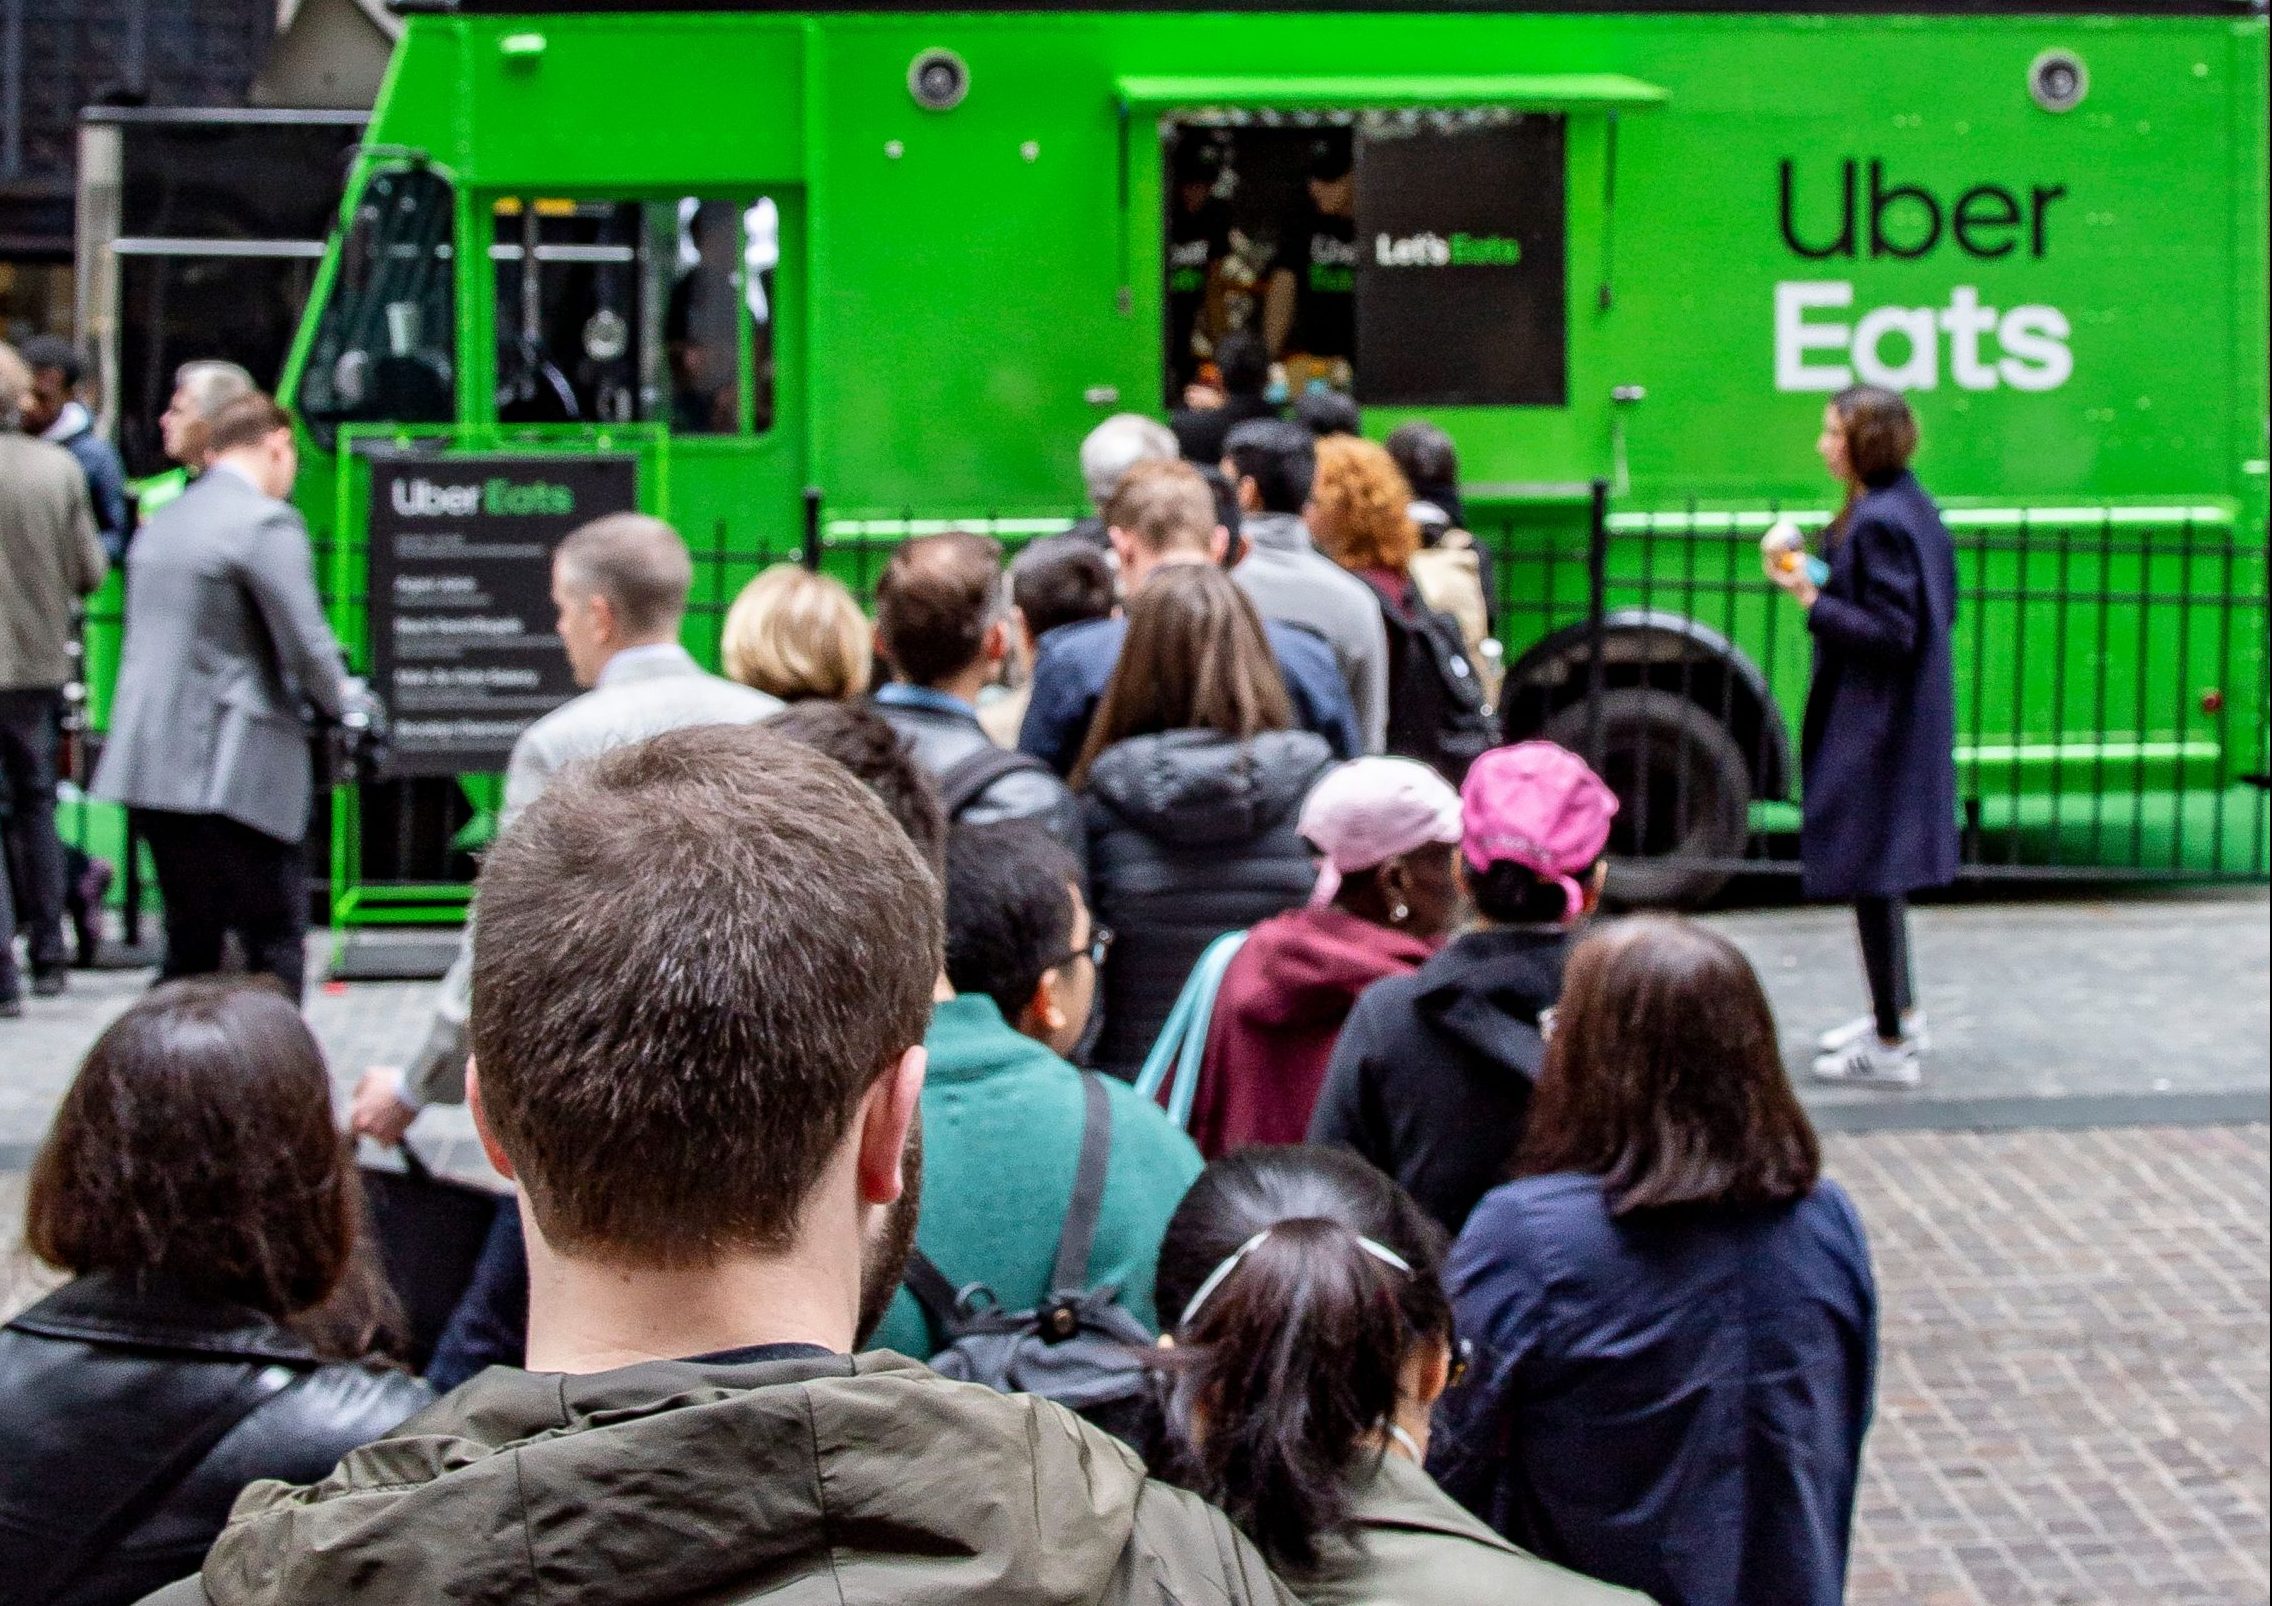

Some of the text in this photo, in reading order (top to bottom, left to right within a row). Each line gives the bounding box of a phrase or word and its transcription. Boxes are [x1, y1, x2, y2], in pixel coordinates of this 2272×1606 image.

[1777, 157, 2067, 261] Uber
[1375, 231, 1449, 266] Let's
[1774, 280, 2073, 391] Eats
[391, 478, 575, 516] Uber Eats
